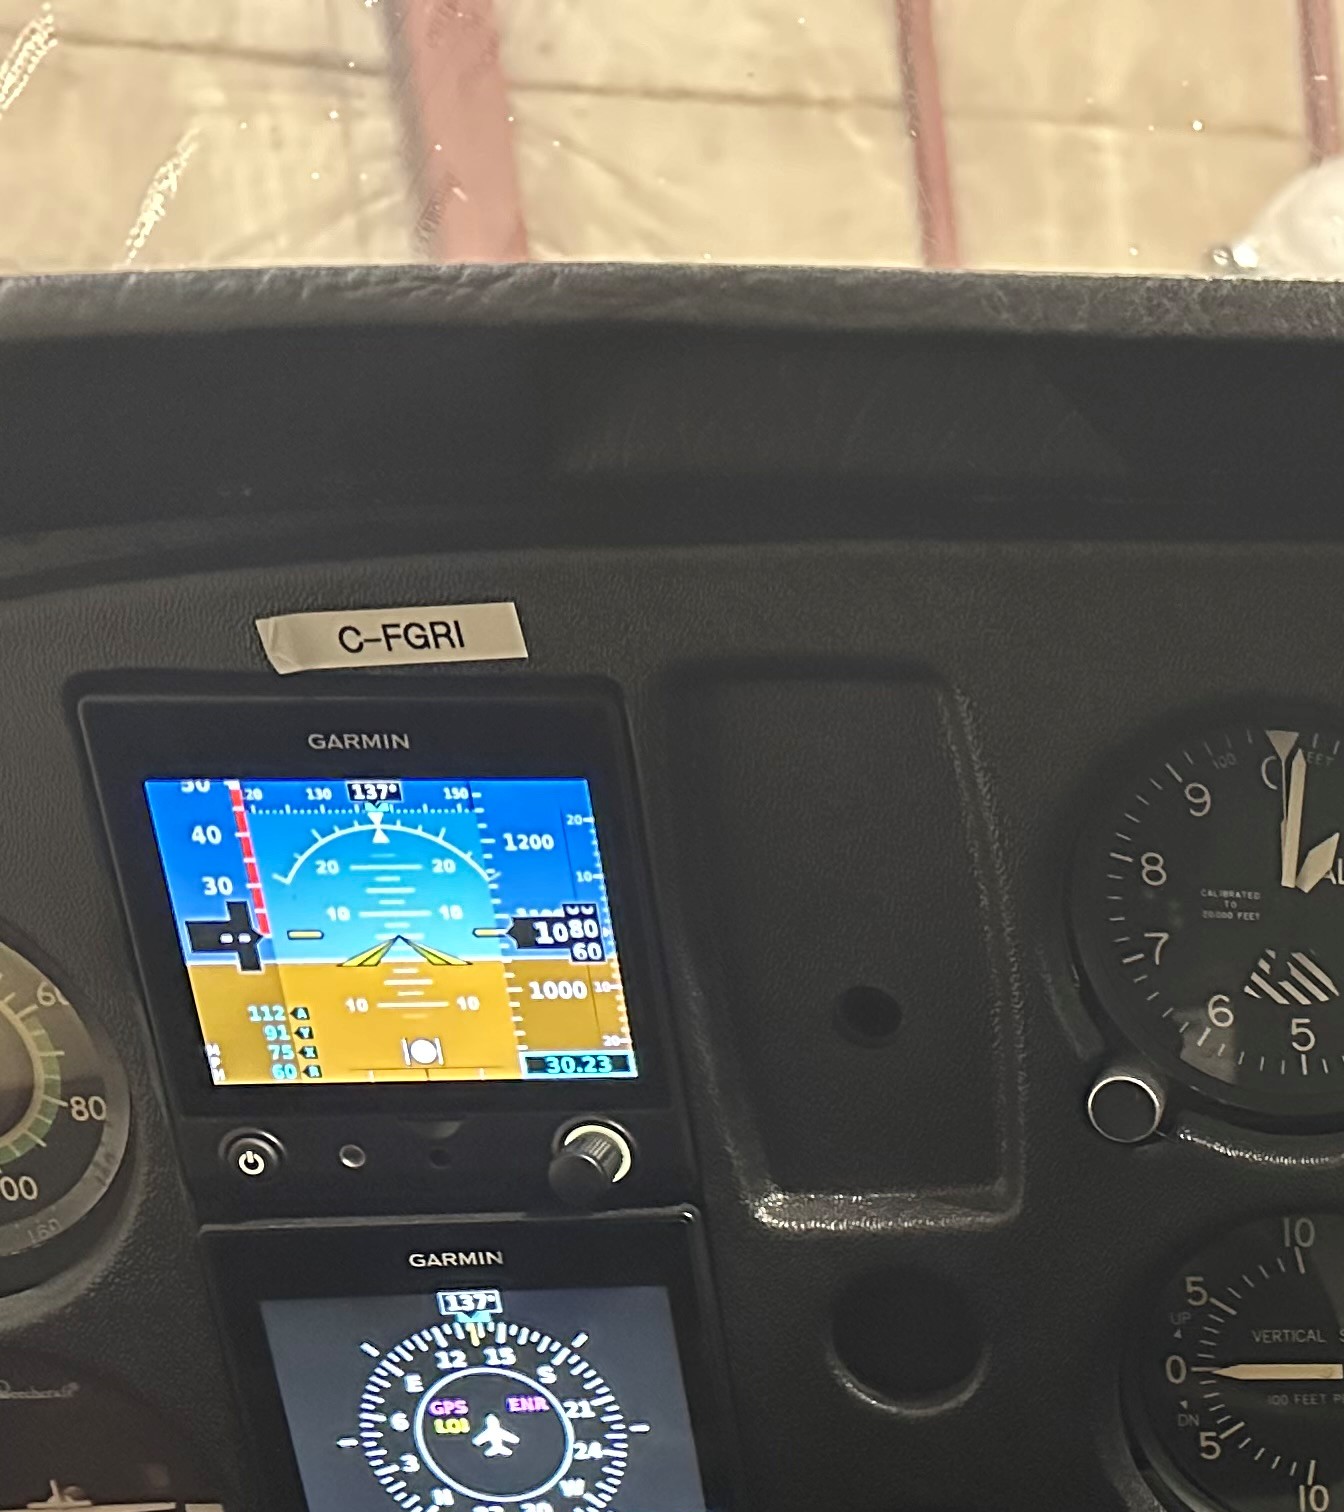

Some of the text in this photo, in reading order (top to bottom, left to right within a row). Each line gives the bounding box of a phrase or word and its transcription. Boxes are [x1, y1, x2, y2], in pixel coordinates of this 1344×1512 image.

[338, 621, 466, 654] C-FGRI
[308, 733, 410, 751] GARMIN
[1184, 783, 1211, 816] 9
[191, 826, 222, 845] 40
[504, 833, 554, 852] 1200
[1140, 851, 1167, 886] 8
[203, 876, 233, 896] 30
[530, 981, 588, 1000] 1000
[1290, 1018, 1315, 1051] 5
[545, 1056, 612, 1074] 30.23
[409, 1251, 503, 1269] GARMIN
[1252, 1328, 1327, 1344] VERTICAL
[429, 1399, 468, 1415] GPS
[508, 1396, 549, 1412] ENR
[1299, 1484, 1329, 1512] 10
